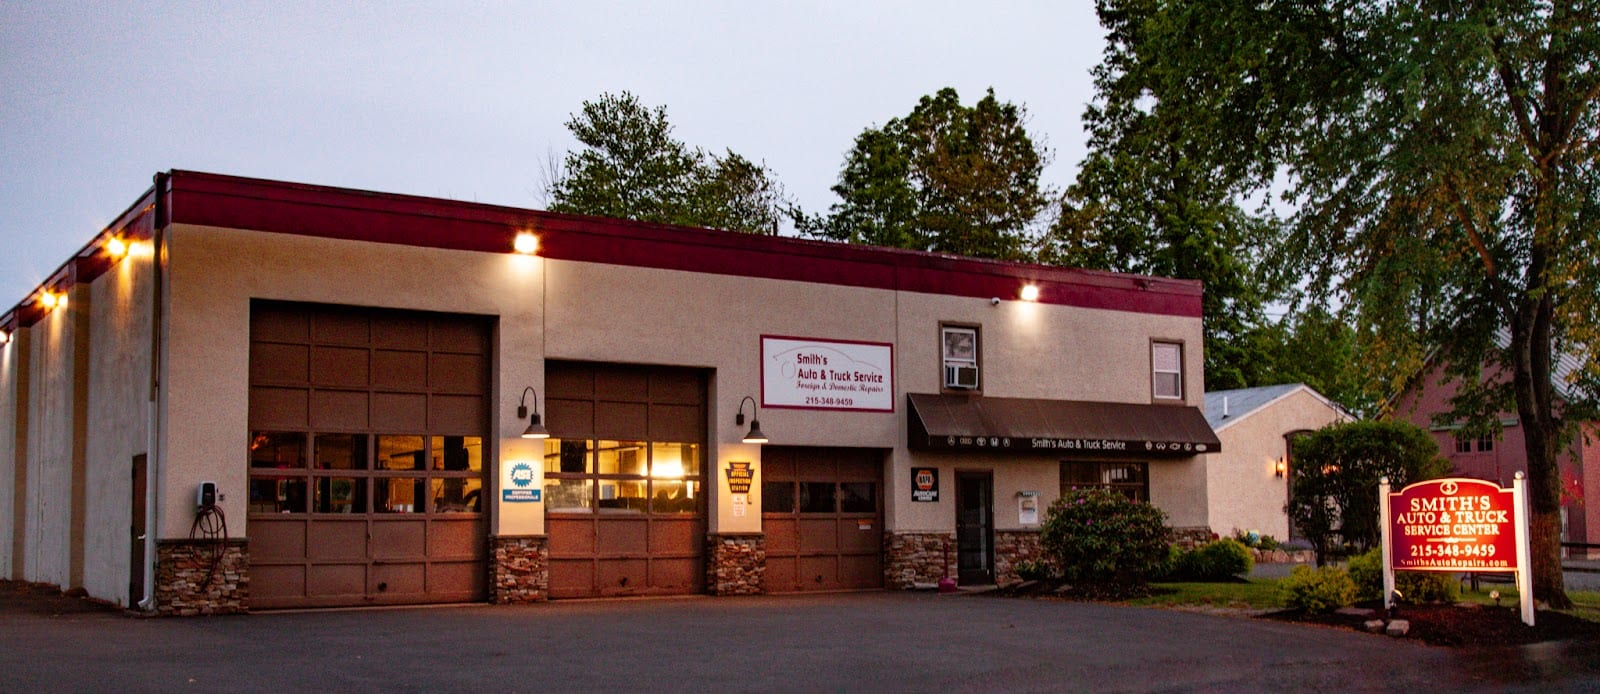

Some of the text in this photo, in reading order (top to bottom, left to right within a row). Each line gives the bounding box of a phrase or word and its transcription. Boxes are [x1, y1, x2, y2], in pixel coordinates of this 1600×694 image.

[797, 353, 828, 365] Smith's
[798, 368, 883, 383] Auto & Truck Service
[821, 382, 828, 391] &
[829, 383, 857, 393] Domestic
[858, 384, 884, 394] Repairs
[805, 396, 853, 406] 215-348-9459
[1032, 438, 1126, 450] Smith's Auto & Truck Service
[1410, 495, 1491, 512] SMITH'S
[1396, 510, 1509, 524] AUTO & TRUCK
[1404, 524, 1500, 536] SERVICE CENTER
[1411, 544, 1496, 557] 215-348-9459
